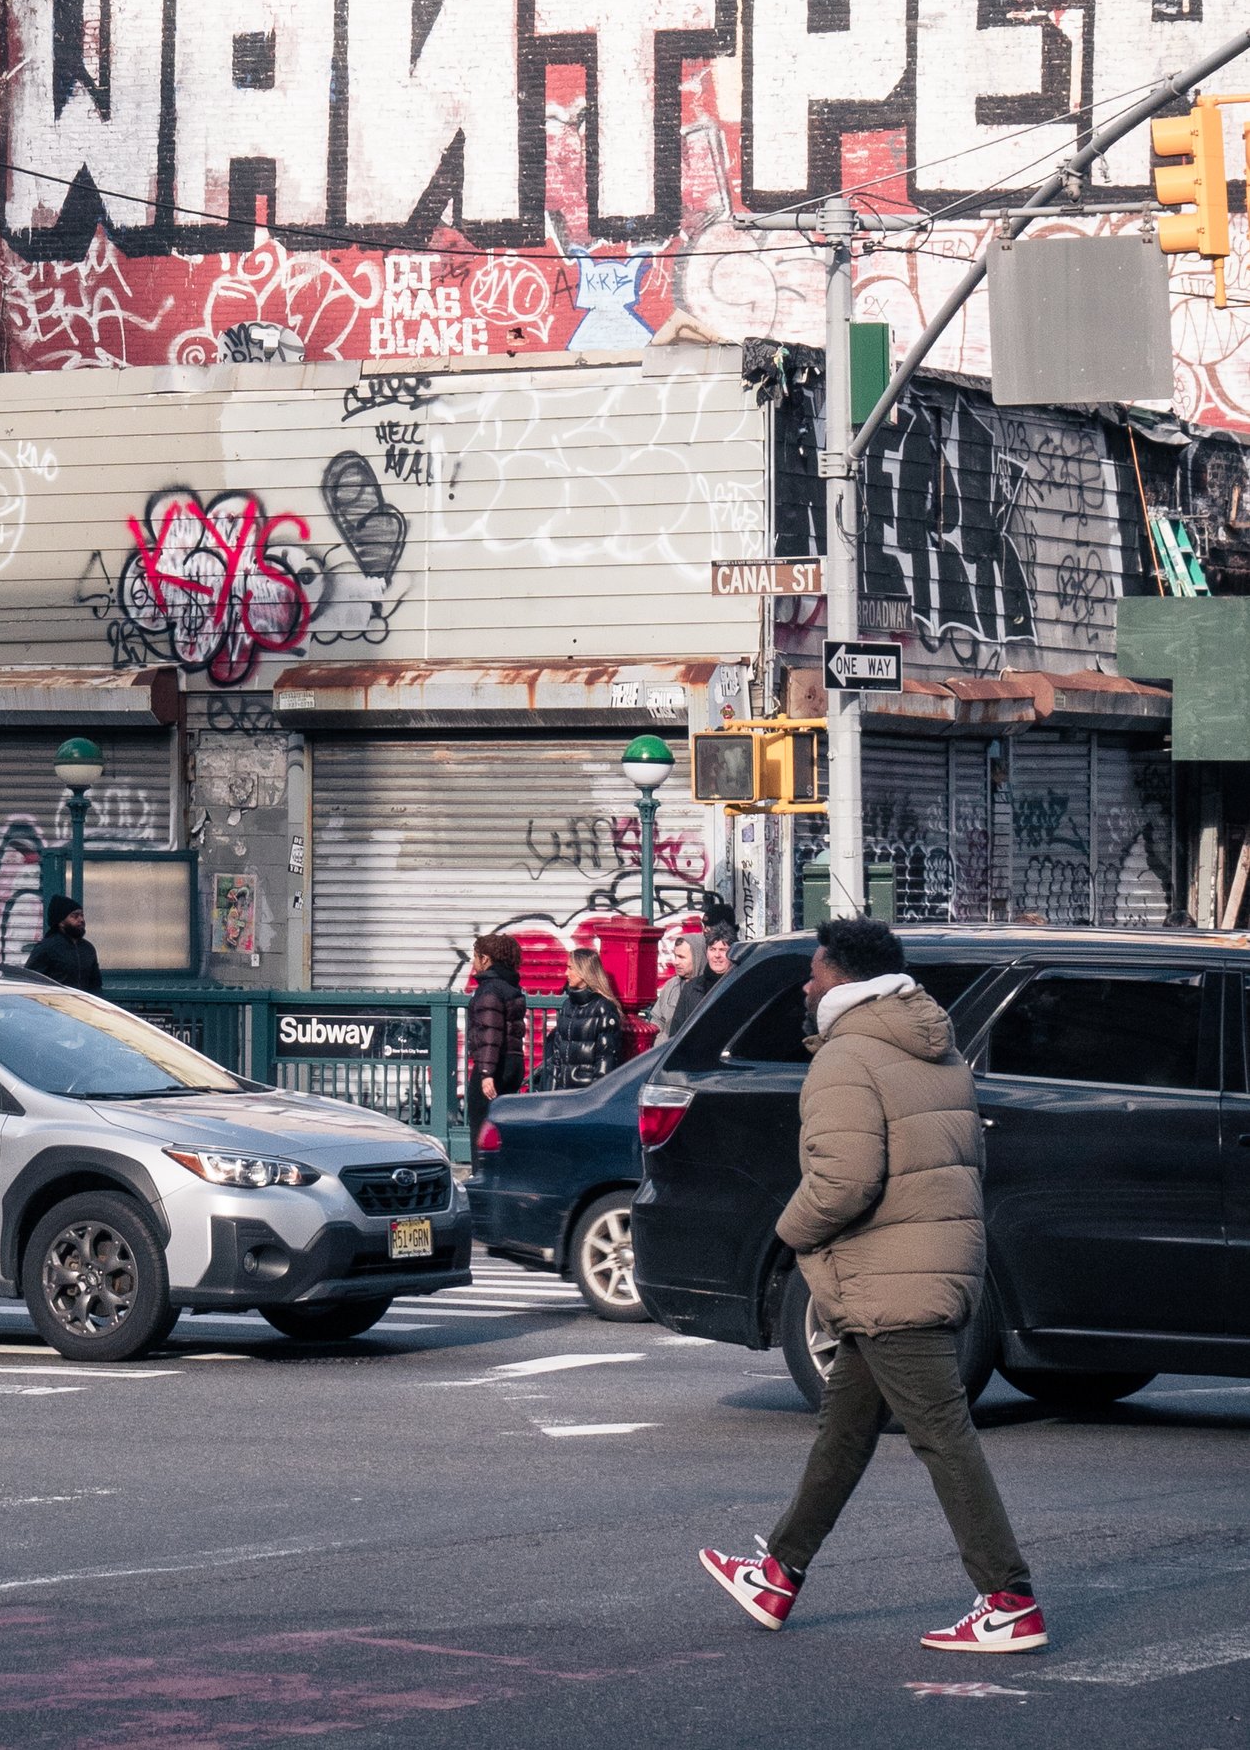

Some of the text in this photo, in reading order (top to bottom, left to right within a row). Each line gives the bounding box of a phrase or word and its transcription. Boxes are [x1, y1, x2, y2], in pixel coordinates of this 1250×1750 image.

[369, 318, 489, 358] BLAKE
[376, 420, 424, 445] HELL
[717, 563, 817, 594] CANAL ST
[856, 599, 909, 629] BROADWAY
[835, 656, 892, 677] ONE WAY
[279, 1016, 375, 1050] Subway
